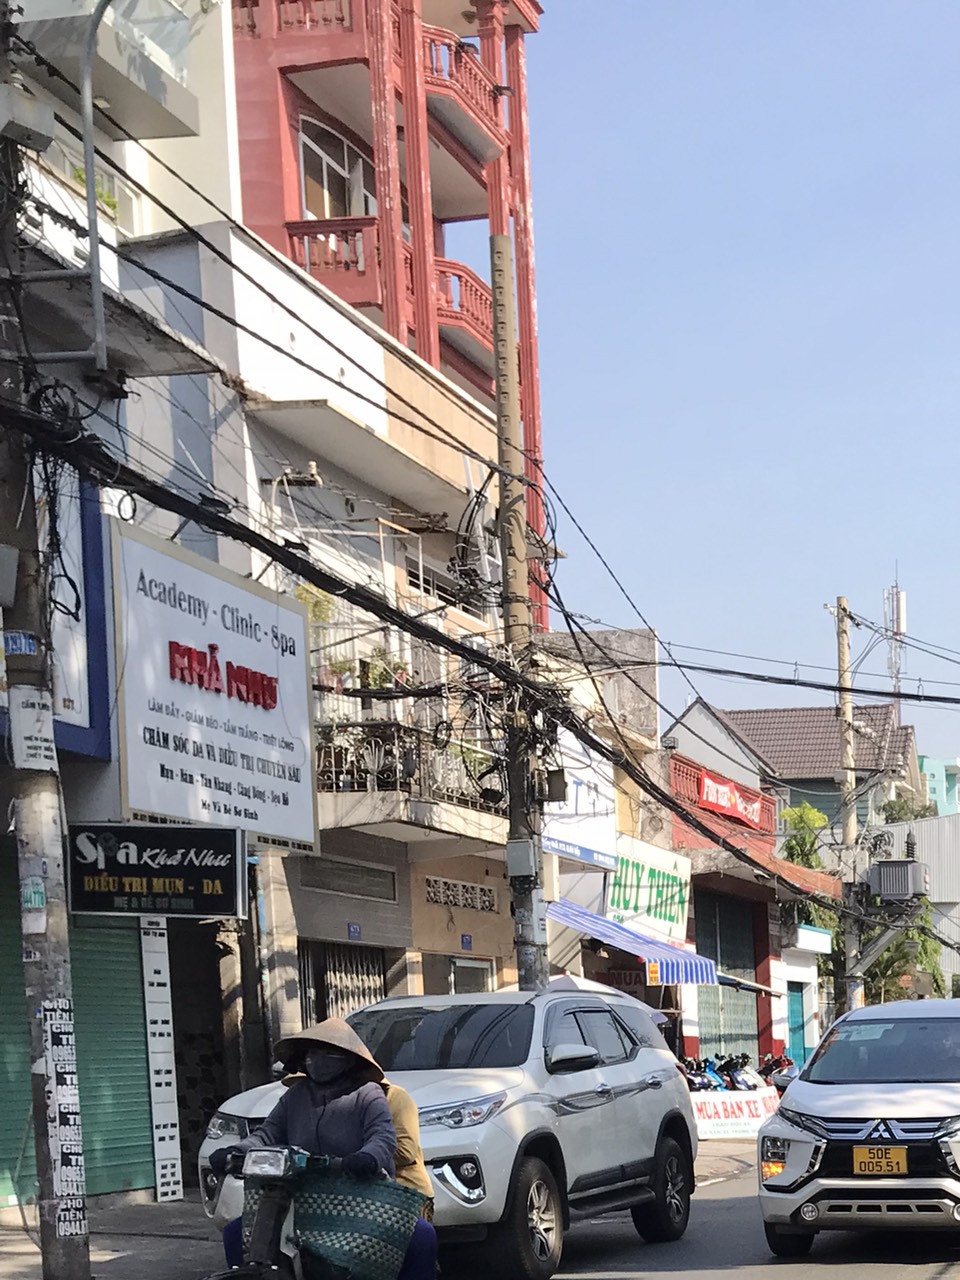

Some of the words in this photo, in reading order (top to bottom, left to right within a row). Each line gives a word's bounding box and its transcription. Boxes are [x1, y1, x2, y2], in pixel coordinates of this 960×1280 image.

[136, 568, 210, 626] Academy
[221, 604, 262, 643] Clinic
[271, 625, 296, 657] Spa
[193, 740, 204, 759] DA
[202, 879, 223, 895] DA
[610, 855, 645, 913] HUY
[695, 1101, 721, 1120] MUA
[721, 1096, 745, 1119] BÁN
[745, 1100, 761, 1118] XE
[868, 1148, 892, 1160] 50E
[859, 1161, 901, 1172] 005.51
